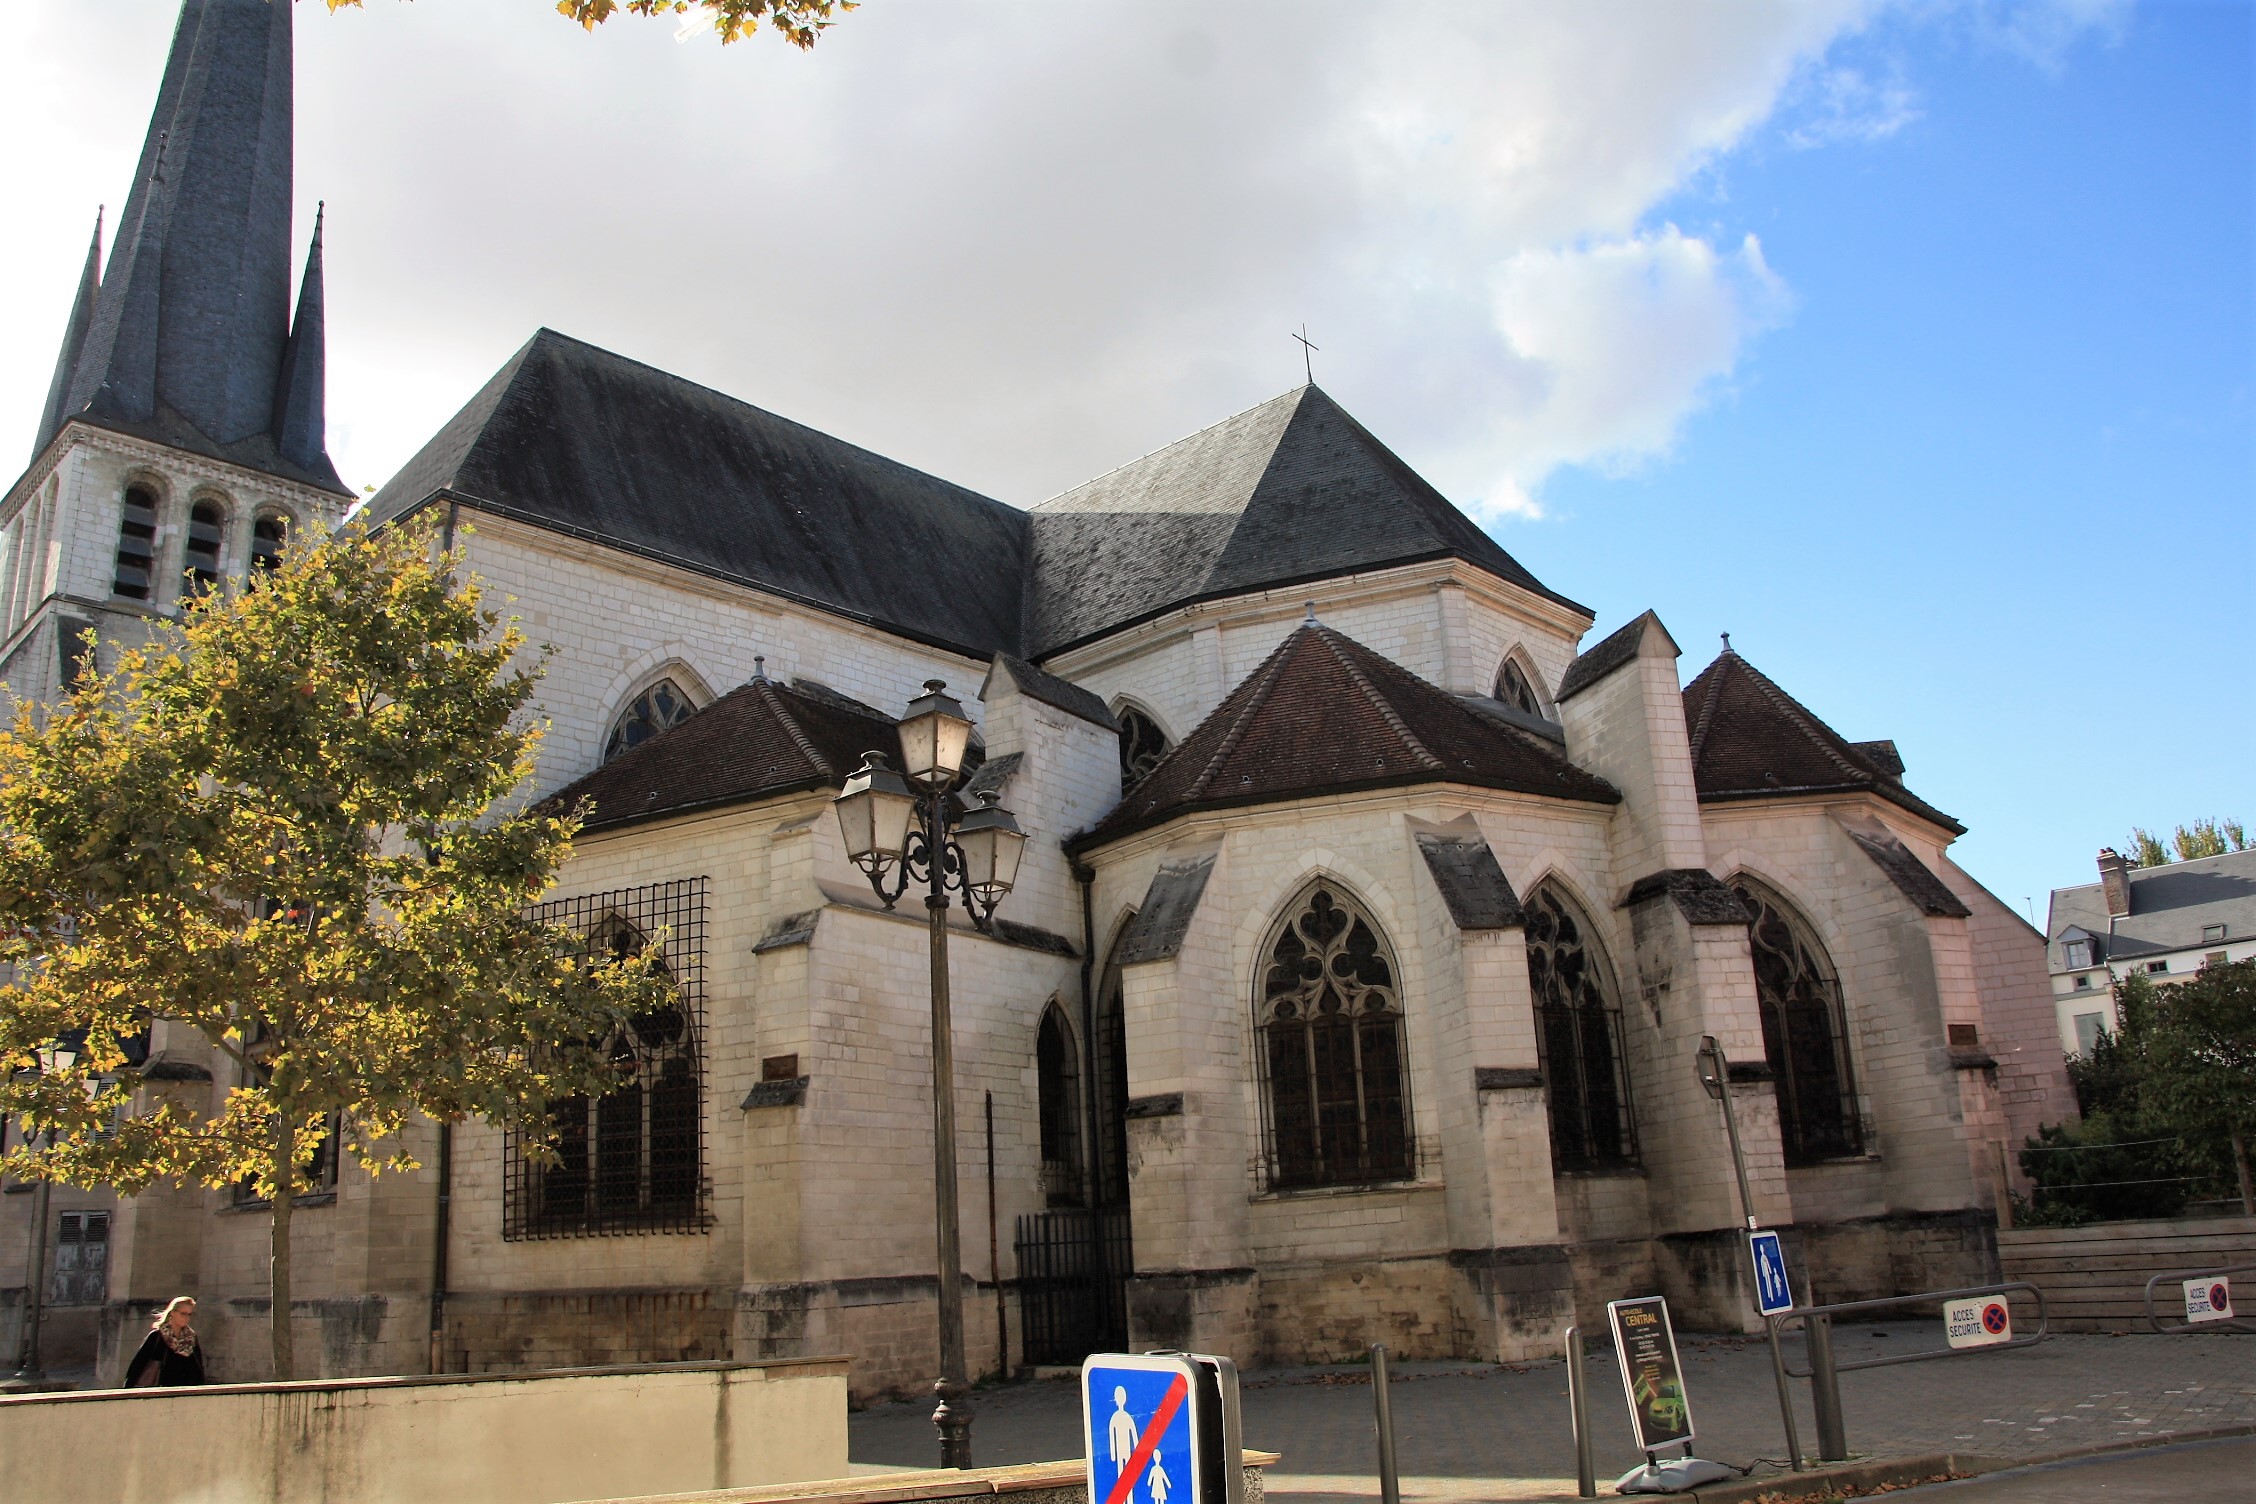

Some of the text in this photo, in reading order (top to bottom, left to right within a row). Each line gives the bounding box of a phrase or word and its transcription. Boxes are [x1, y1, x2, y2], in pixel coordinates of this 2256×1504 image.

[2189, 1287, 2205, 1299] ACCES
[2188, 1301, 2211, 1313] SECURITE
[1625, 1313, 1658, 1327] CENTRAL
[1952, 1309, 1974, 1322] ACCES
[1949, 1322, 1981, 1338] SECURITE
